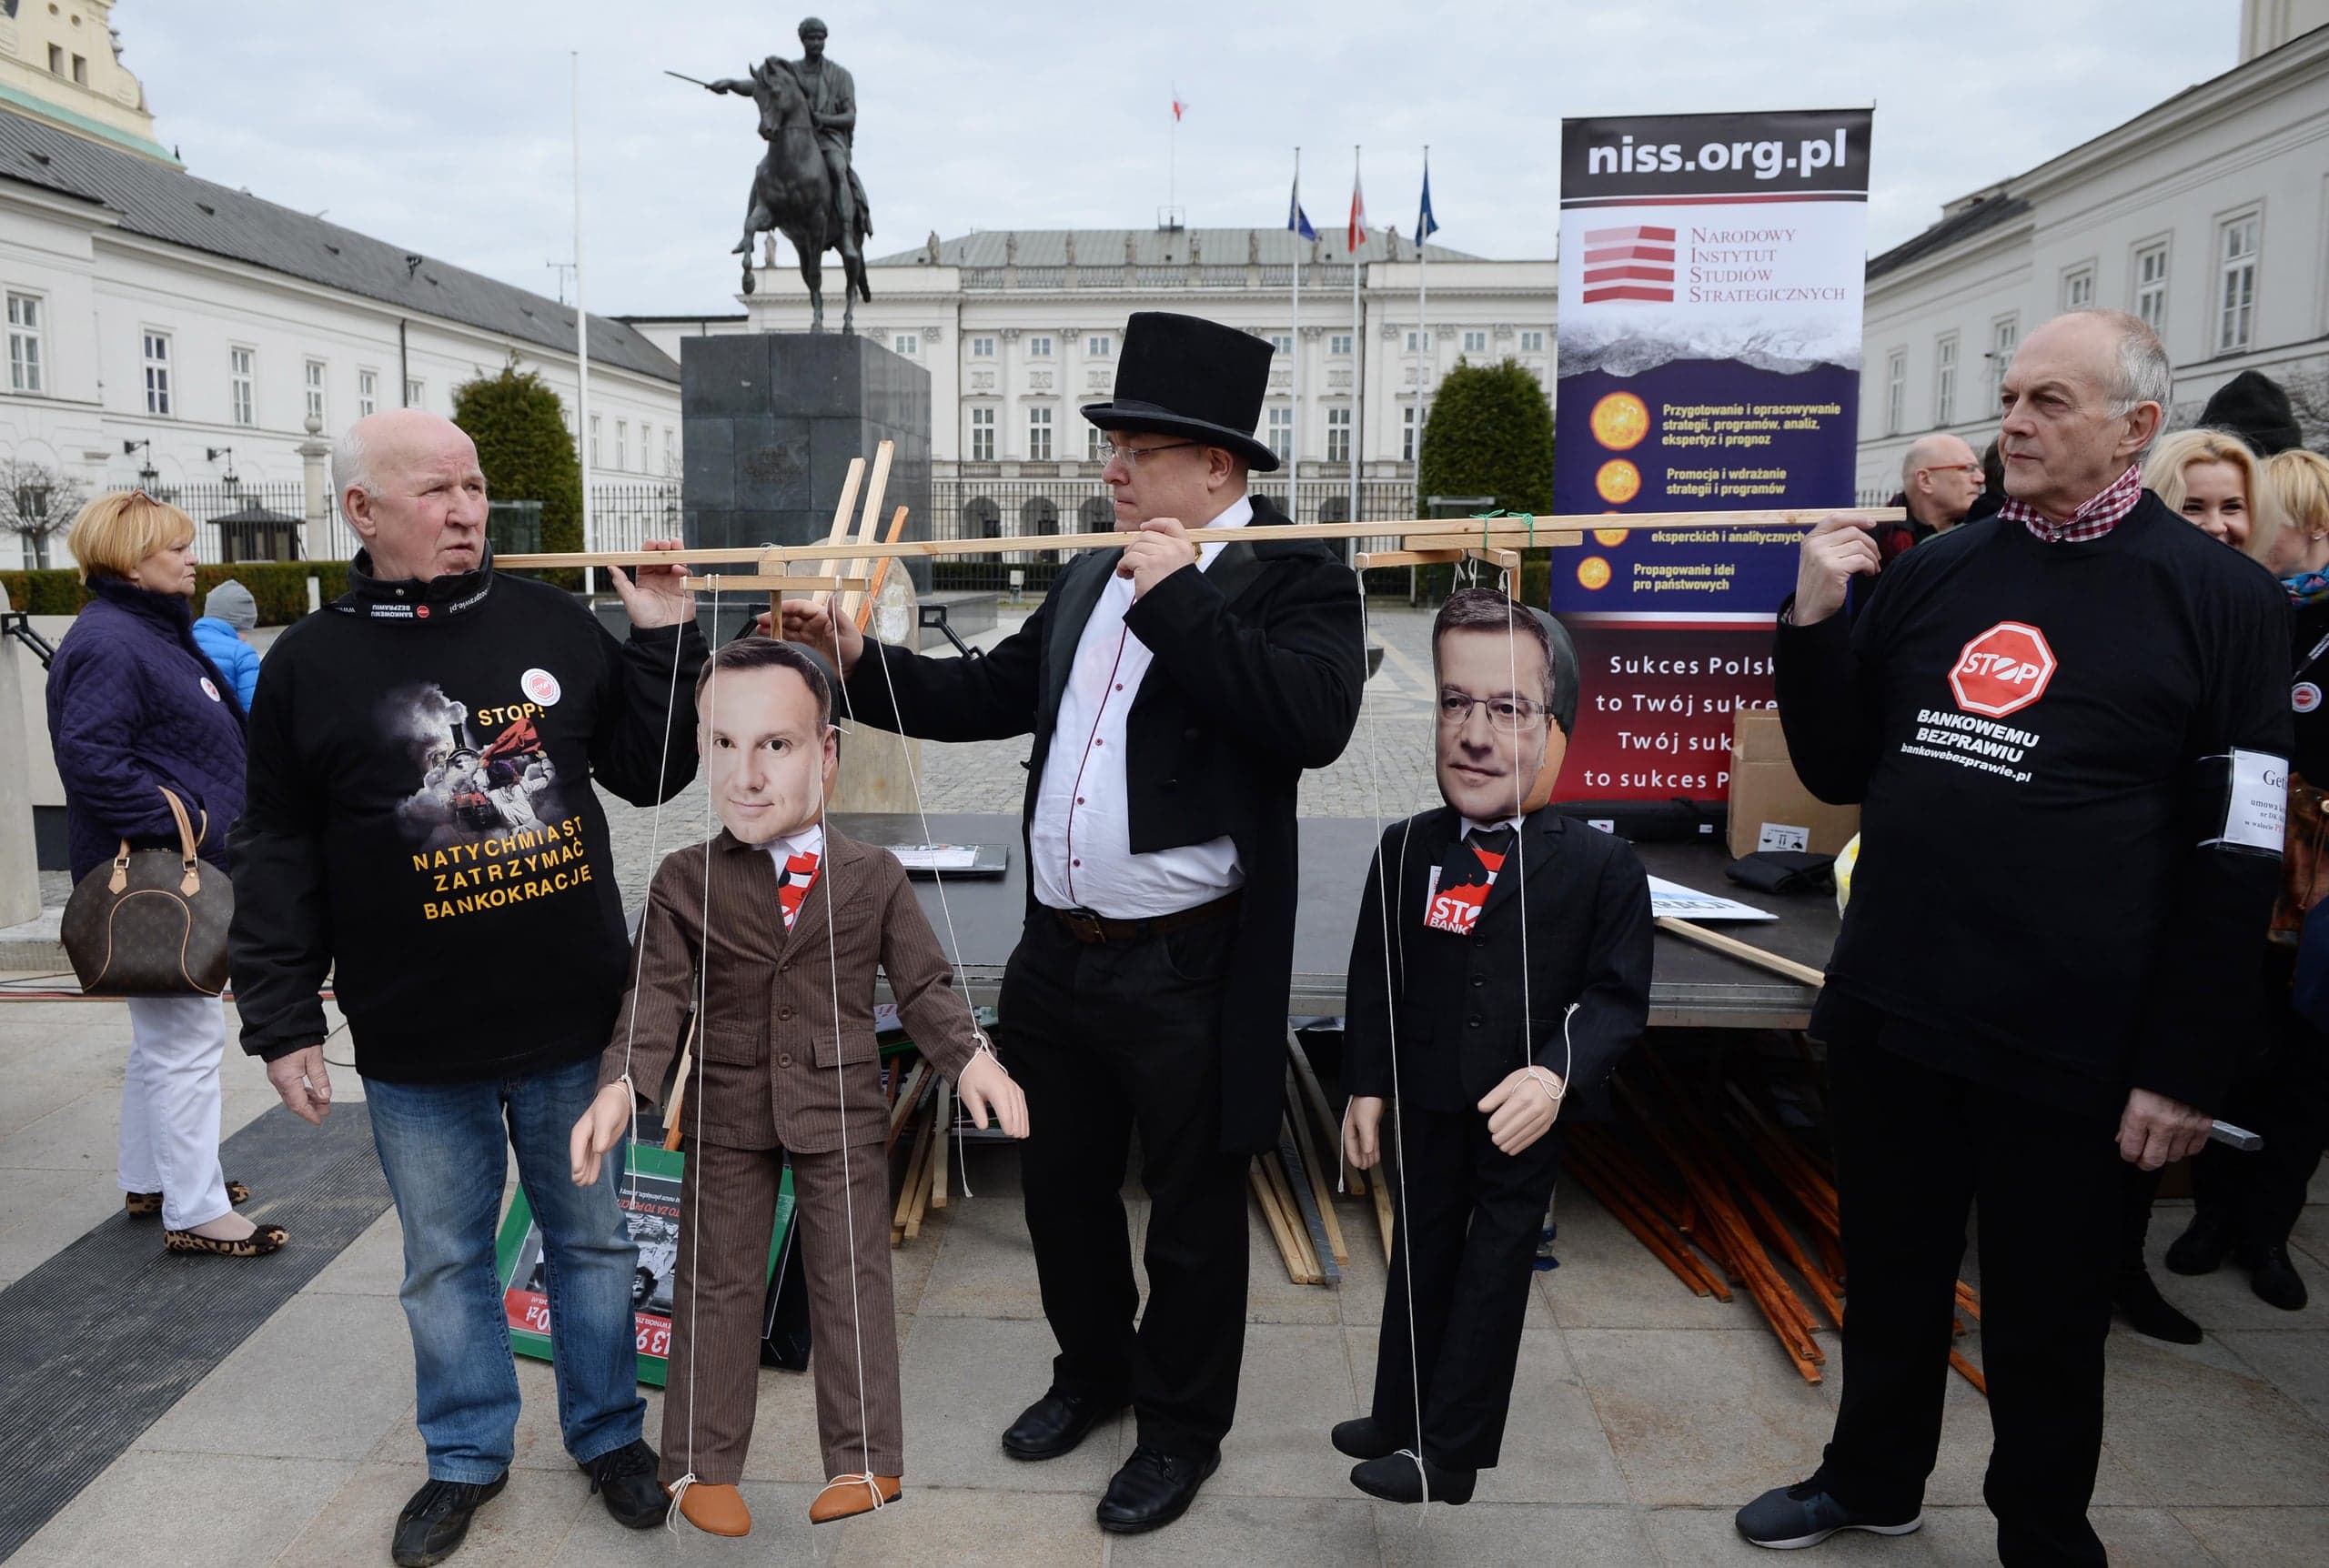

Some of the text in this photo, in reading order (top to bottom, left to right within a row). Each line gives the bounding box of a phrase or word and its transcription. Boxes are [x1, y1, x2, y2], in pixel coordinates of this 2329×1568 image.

[1588, 128, 1847, 180] niss.org.pl
[1690, 227, 1796, 244] NARODOWY
[1691, 246, 1777, 263] INSTYTUT
[1689, 286, 1846, 303] STRATEGICZNYCH
[1663, 404, 1744, 417] Przygotowanie
[1753, 402, 1841, 417] opracowywanie
[1662, 434, 1716, 447] ekspertyz
[1725, 435, 1771, 447] prognoz
[1667, 467, 1719, 482] Promocja
[1729, 467, 1787, 480] wdrażanie
[1667, 483, 1711, 498] strategii
[1720, 482, 1785, 498] programów
[1651, 530, 1719, 545] eksperckich
[1729, 530, 1805, 545] analitycznych
[1634, 563, 1735, 578] Propagowanie idei
[1633, 578, 1729, 593] pro państwowych
[1610, 656, 1699, 674] Sukces
[1961, 653, 2040, 684] STOP
[478, 702, 545, 726] STOP!
[1596, 695, 1623, 711] to
[1632, 694, 1693, 717] Twój
[1917, 709, 2040, 749] BANKOWEMU
[1618, 732, 1679, 754] Twój
[1915, 727, 2024, 763] BEZPRAWIU
[1901, 742, 2032, 782] bankowebezprawie.pl
[1584, 770, 1610, 787] to
[1620, 769, 1707, 788] sukces
[412, 816, 584, 871] NATYCHMIAST
[433, 835, 584, 892] ZATRZYMAĆ
[423, 864, 592, 920] BANKOKRACJĘ
